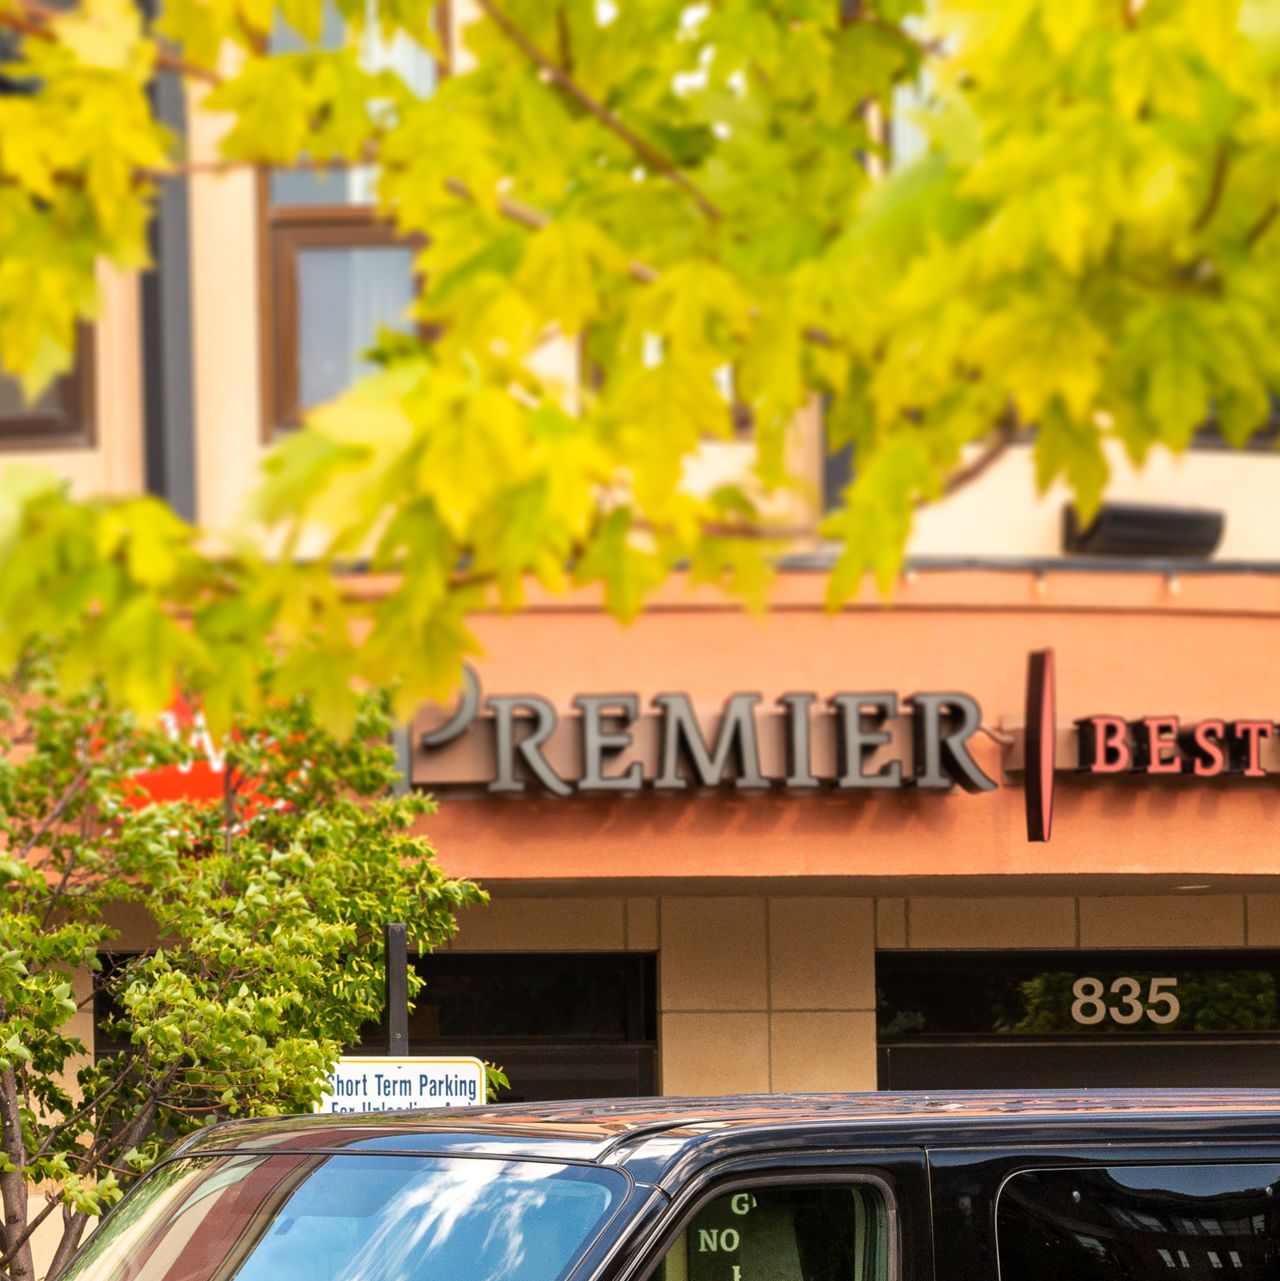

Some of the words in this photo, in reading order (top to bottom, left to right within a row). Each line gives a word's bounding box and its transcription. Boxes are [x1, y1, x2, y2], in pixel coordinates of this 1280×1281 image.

[1084, 715, 1274, 776] BEST
[1070, 976, 1180, 1025] 835
[374, 1074, 412, 1097] Term
[419, 1074, 477, 1100] Parking
